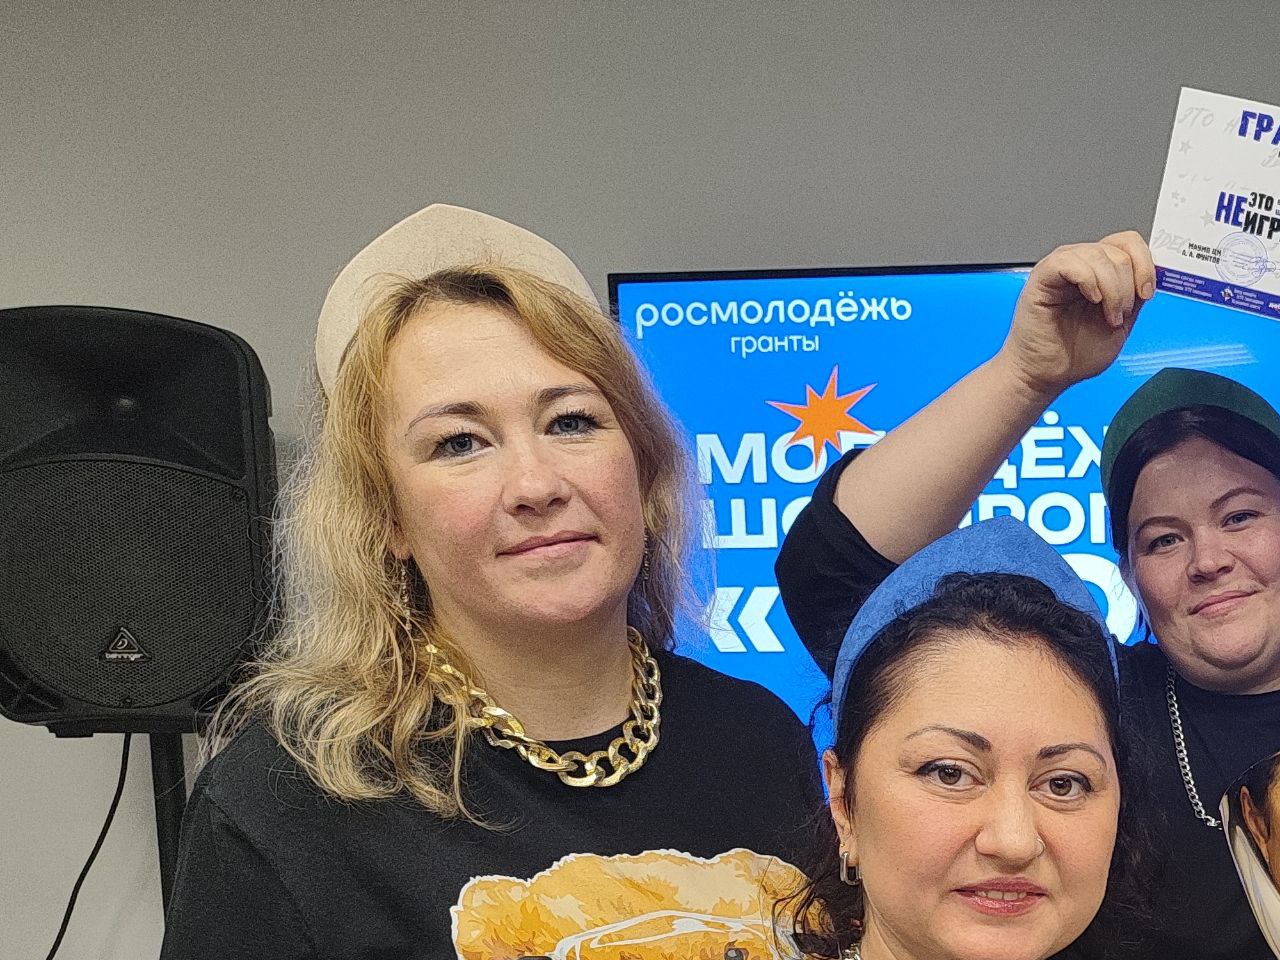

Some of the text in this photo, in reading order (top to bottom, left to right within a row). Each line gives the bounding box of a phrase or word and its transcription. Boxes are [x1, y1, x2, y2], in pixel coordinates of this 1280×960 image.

[1214, 191, 1248, 228] НЕ
[1248, 191, 1274, 212] ЭТО
[635, 290, 912, 339] росмолодёжь
[730, 334, 819, 358] гранты
